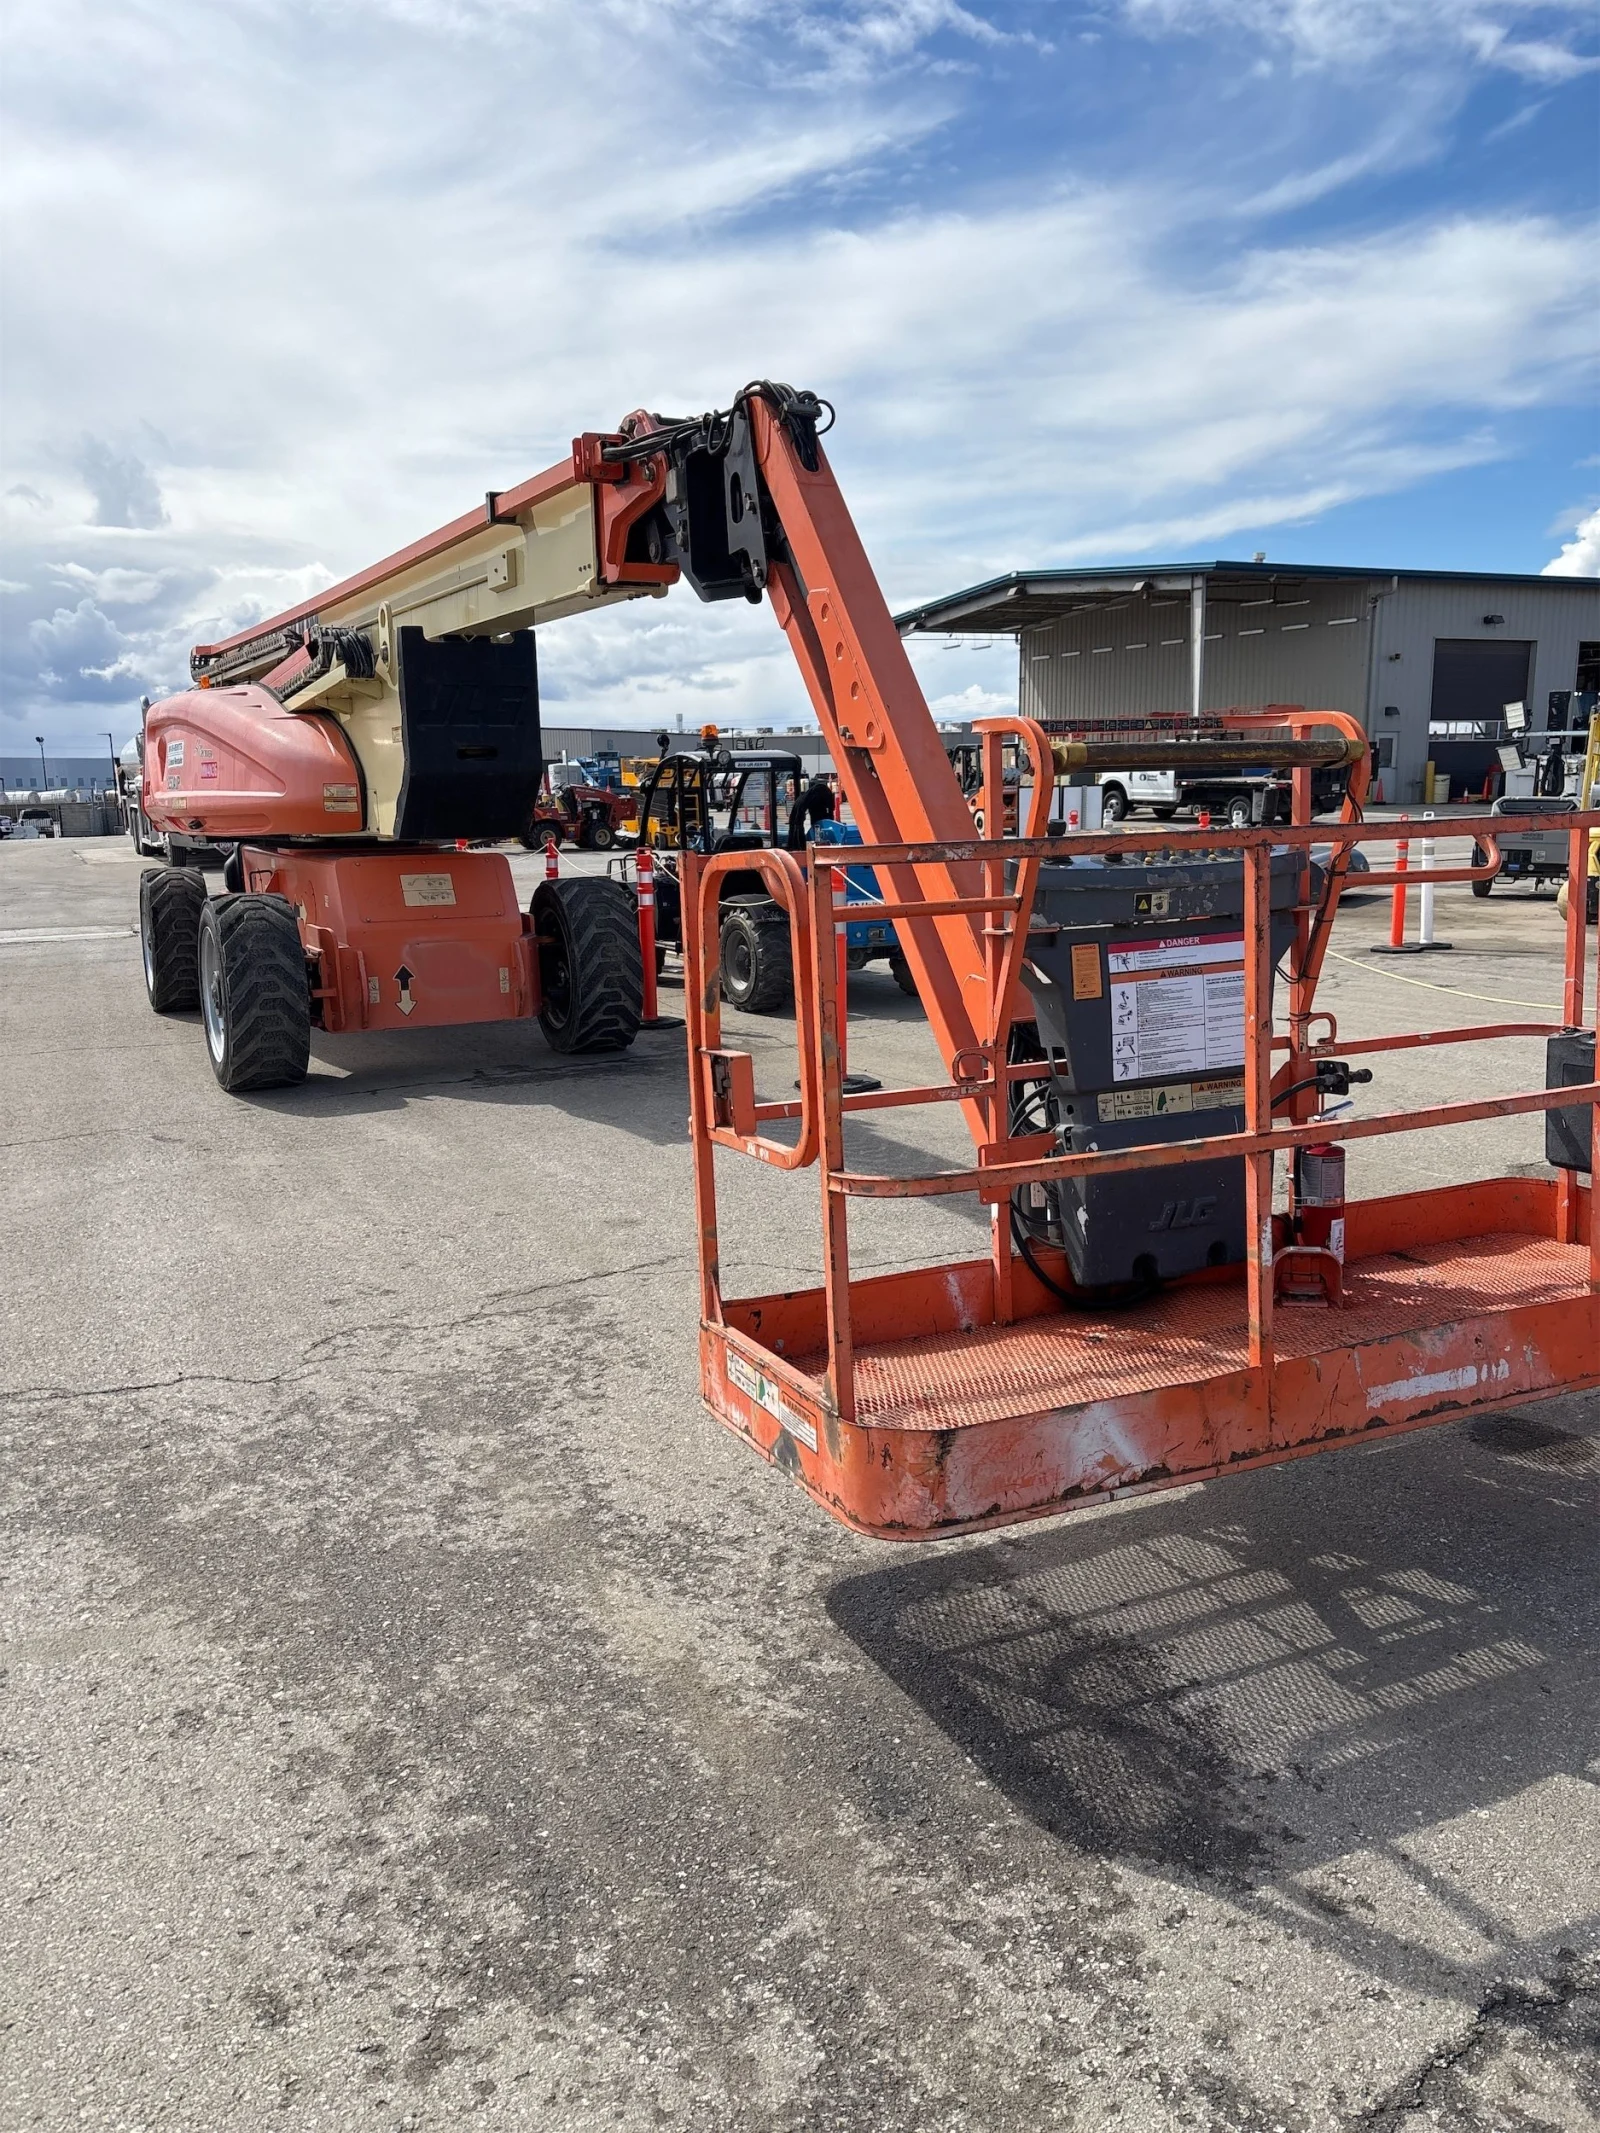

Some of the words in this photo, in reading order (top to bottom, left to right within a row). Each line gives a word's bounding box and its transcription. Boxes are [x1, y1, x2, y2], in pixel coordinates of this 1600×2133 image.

[1166, 936, 1200, 948] DANGER
[1168, 967, 1203, 978] WARNING
[1206, 1080, 1242, 1090] WARNING
